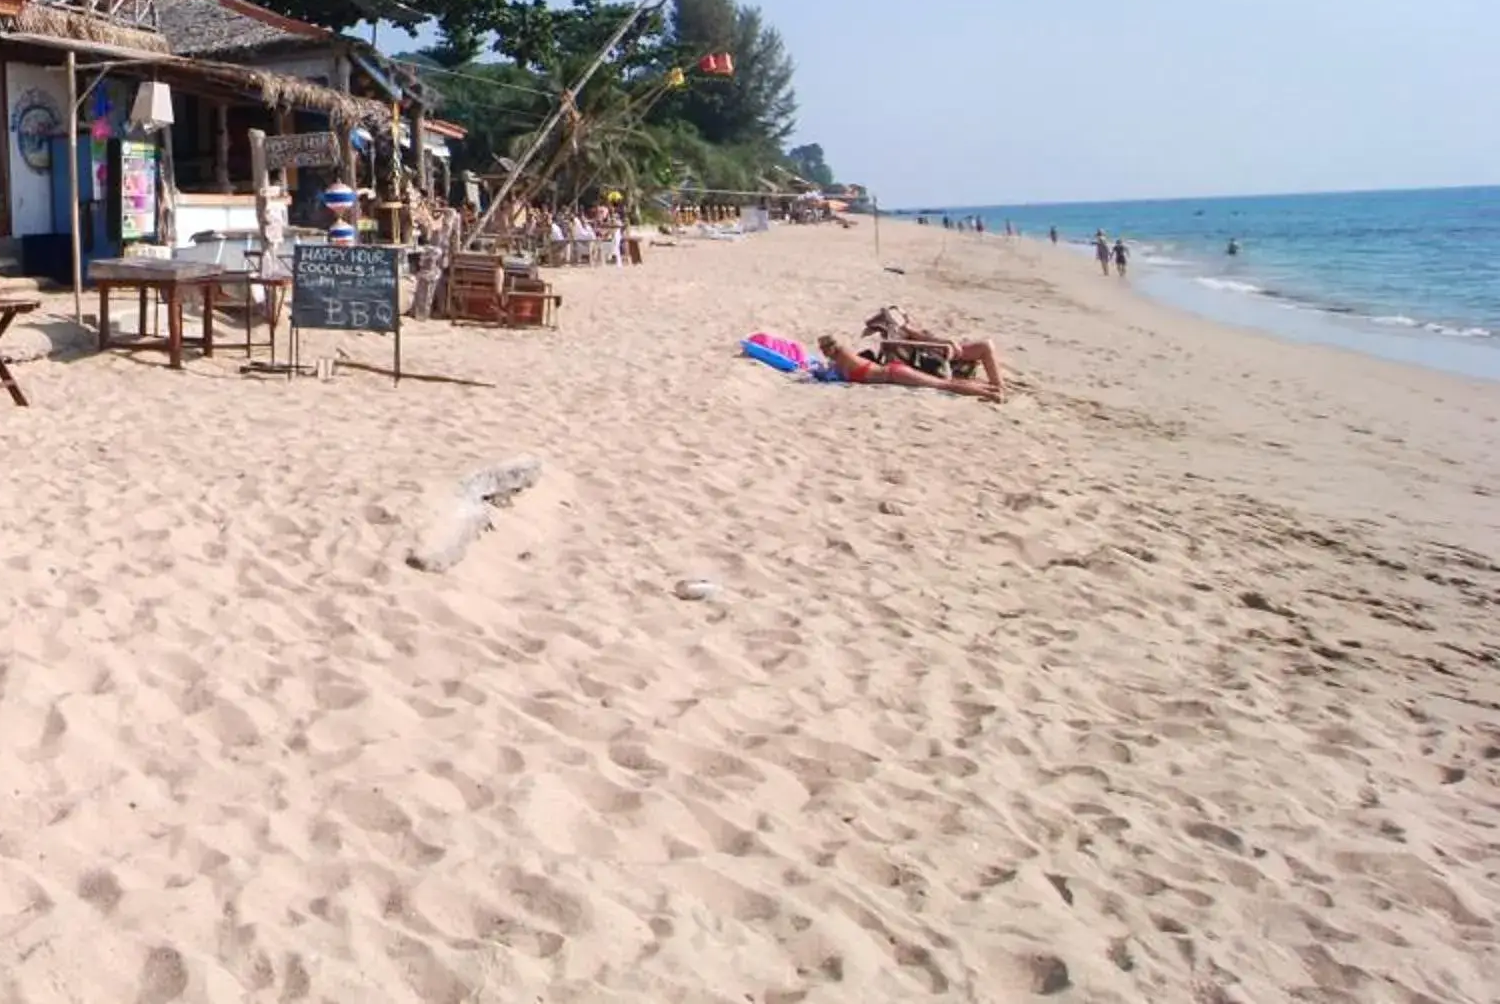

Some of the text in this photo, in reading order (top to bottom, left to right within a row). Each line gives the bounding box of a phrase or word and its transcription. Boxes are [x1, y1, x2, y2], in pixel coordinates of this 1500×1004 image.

[301, 248, 389, 265] HAPPY HOUR
[322, 297, 391, 327] BBQ
